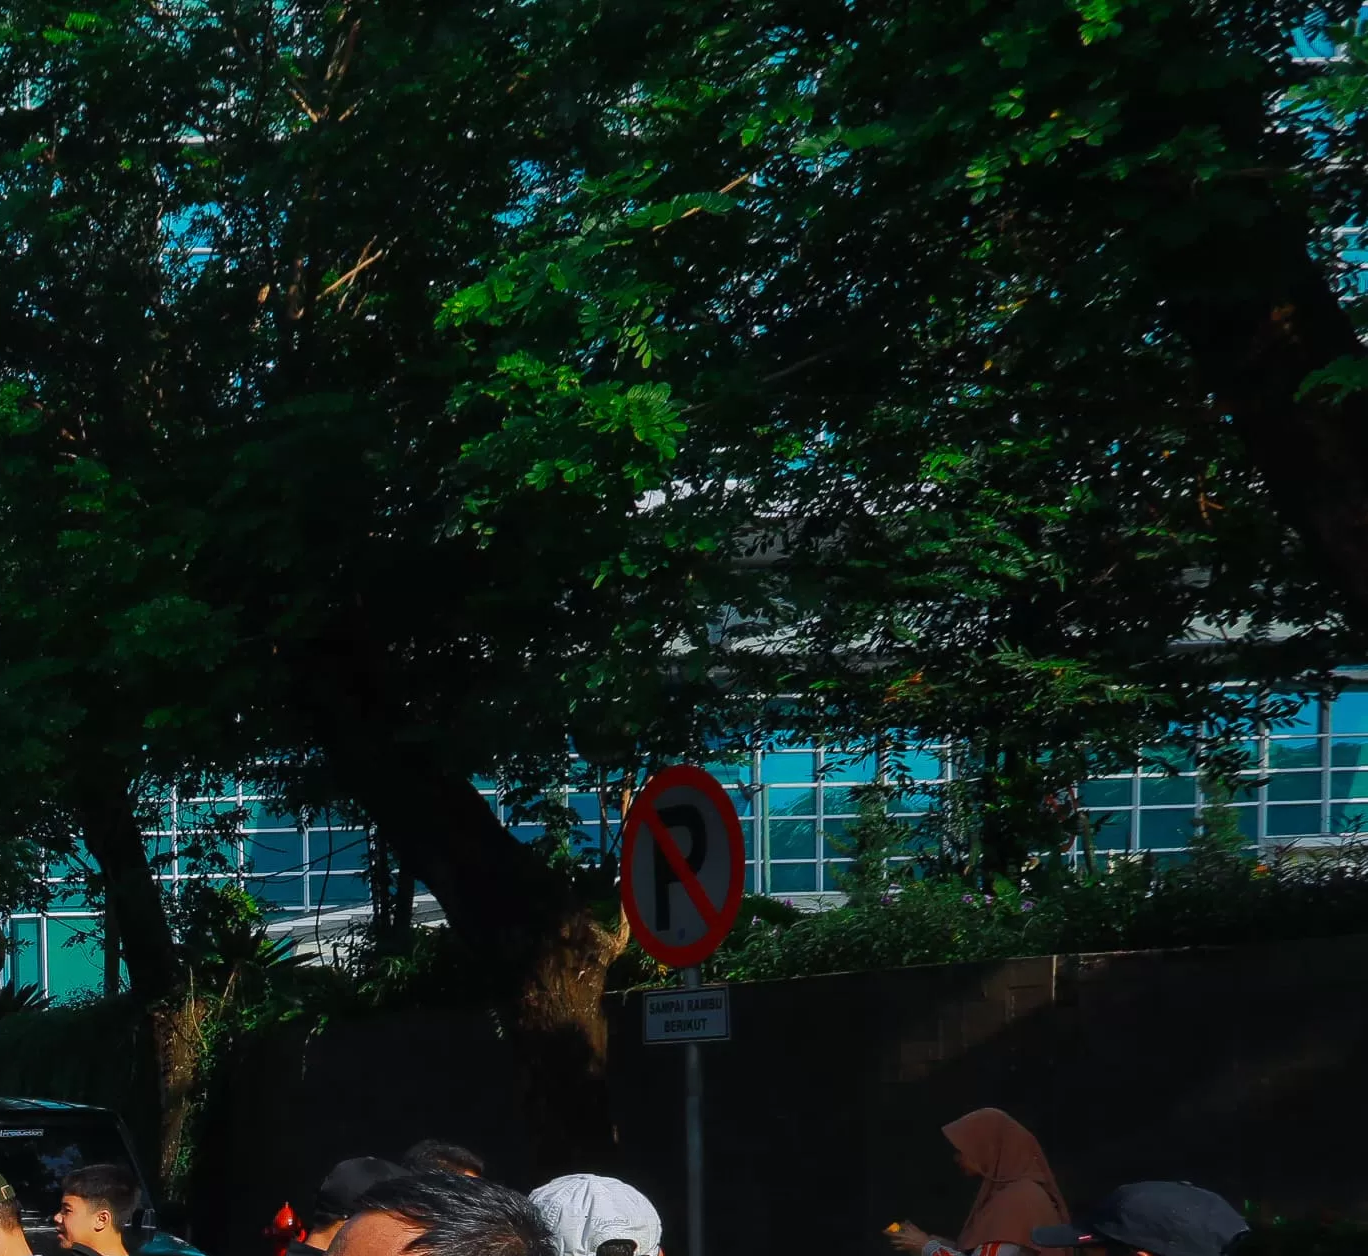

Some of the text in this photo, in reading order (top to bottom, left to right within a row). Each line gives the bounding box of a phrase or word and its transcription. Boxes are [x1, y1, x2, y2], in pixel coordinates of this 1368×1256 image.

[648, 996, 723, 1014] SAMPAI RAMBU
[663, 1018, 708, 1033] BERIKUT
